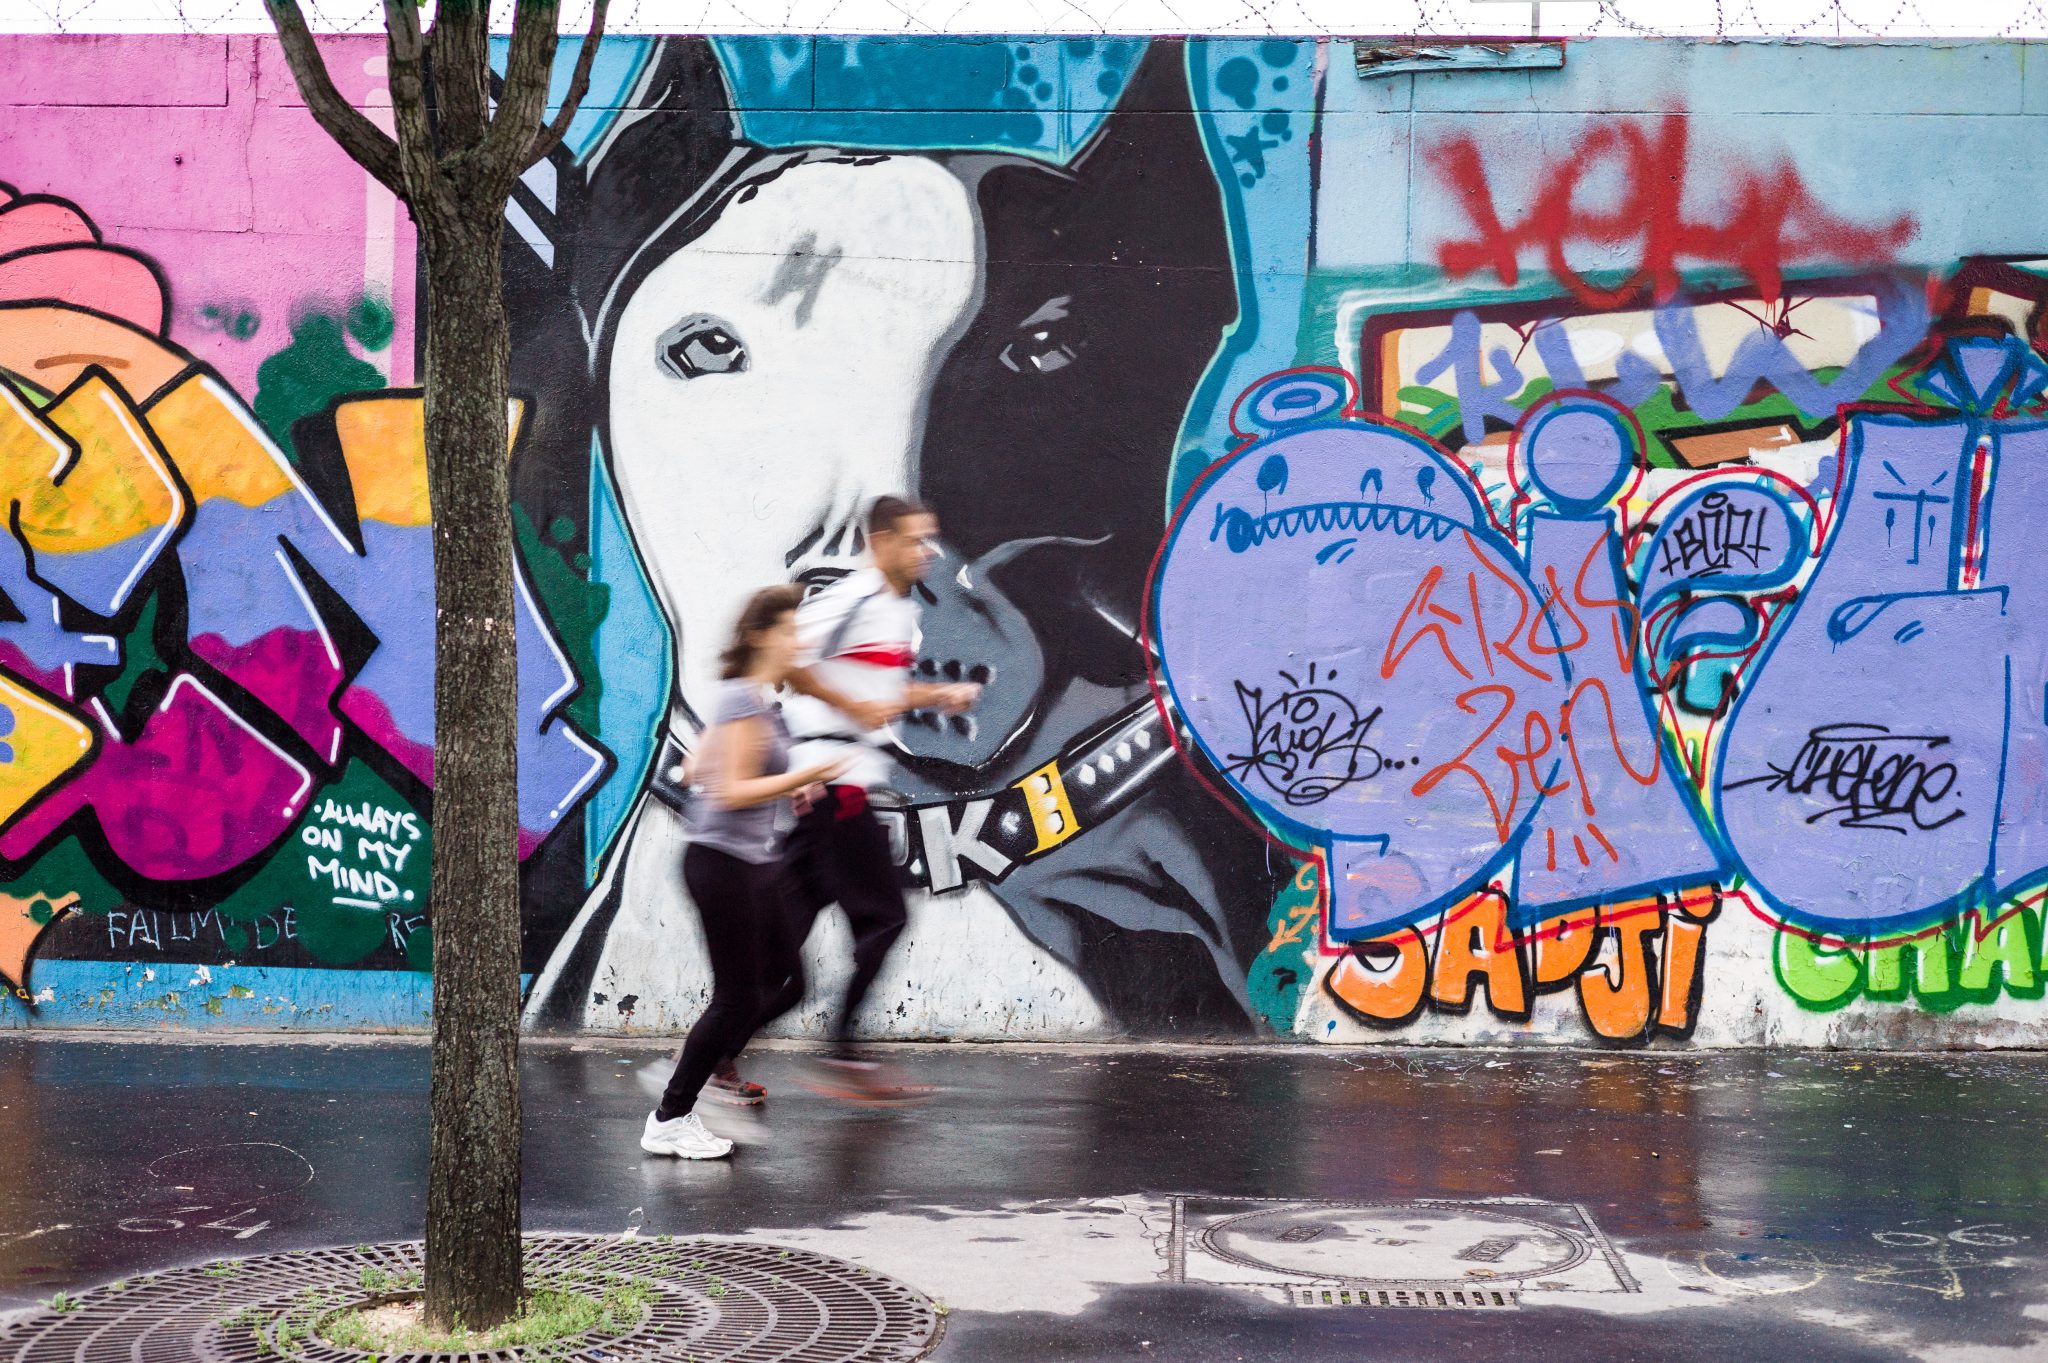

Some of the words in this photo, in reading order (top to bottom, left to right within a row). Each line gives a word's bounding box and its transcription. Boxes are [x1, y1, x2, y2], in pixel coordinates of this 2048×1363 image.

[320, 799, 421, 840] ALWAYS
[301, 825, 342, 852] ON
[357, 837, 412, 872] MY
